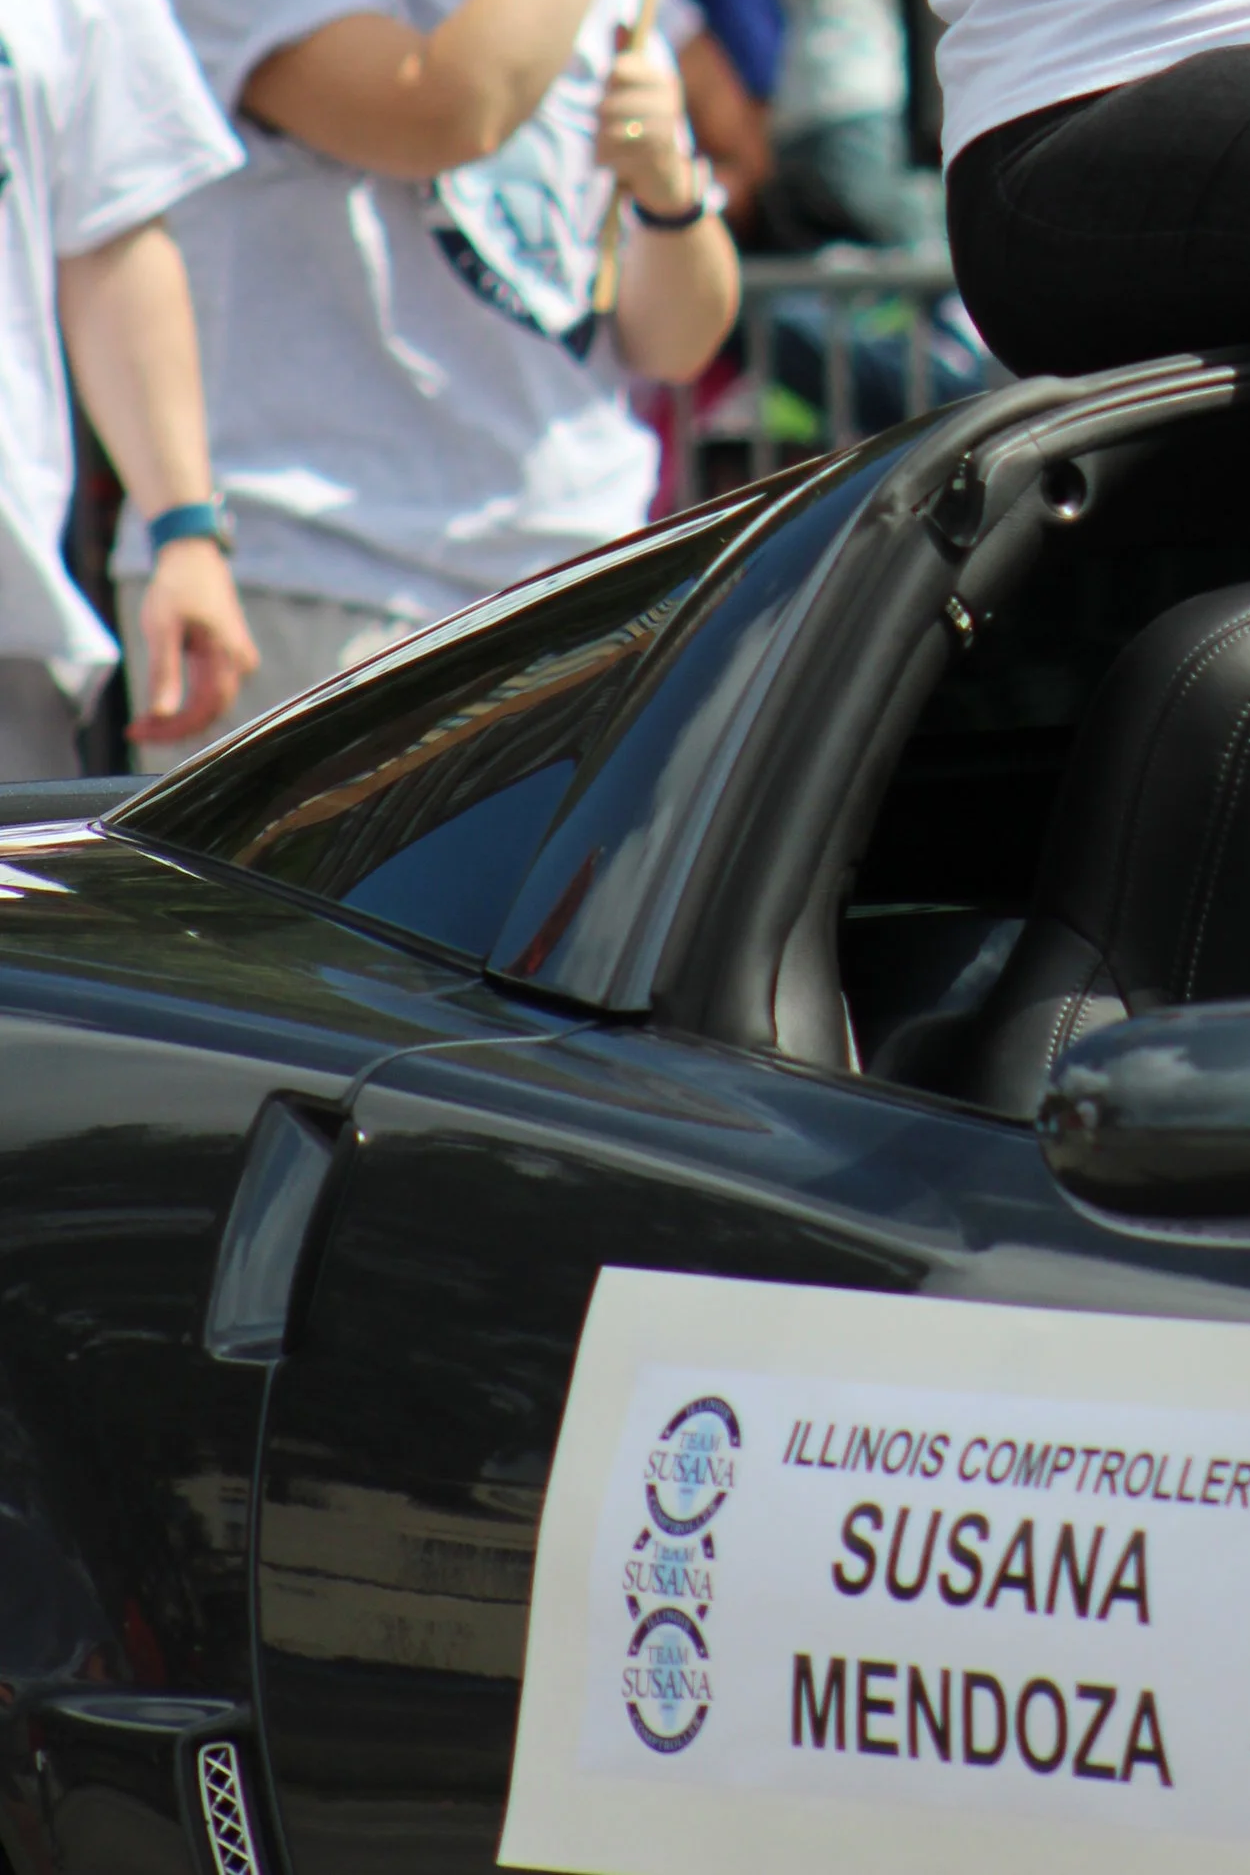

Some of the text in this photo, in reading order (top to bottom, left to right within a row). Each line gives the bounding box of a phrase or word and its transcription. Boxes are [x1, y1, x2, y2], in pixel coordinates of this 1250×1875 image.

[643, 1450, 735, 1489] SUSANA
[782, 1420, 950, 1478] ILLINOIS
[622, 1559, 714, 1601] SUSANA
[831, 1501, 1150, 1626] SUSANA
[646, 1643, 690, 1666] TEAM
[621, 1666, 714, 1702] SUSANA
[791, 1651, 1175, 1790] MENDOZA
